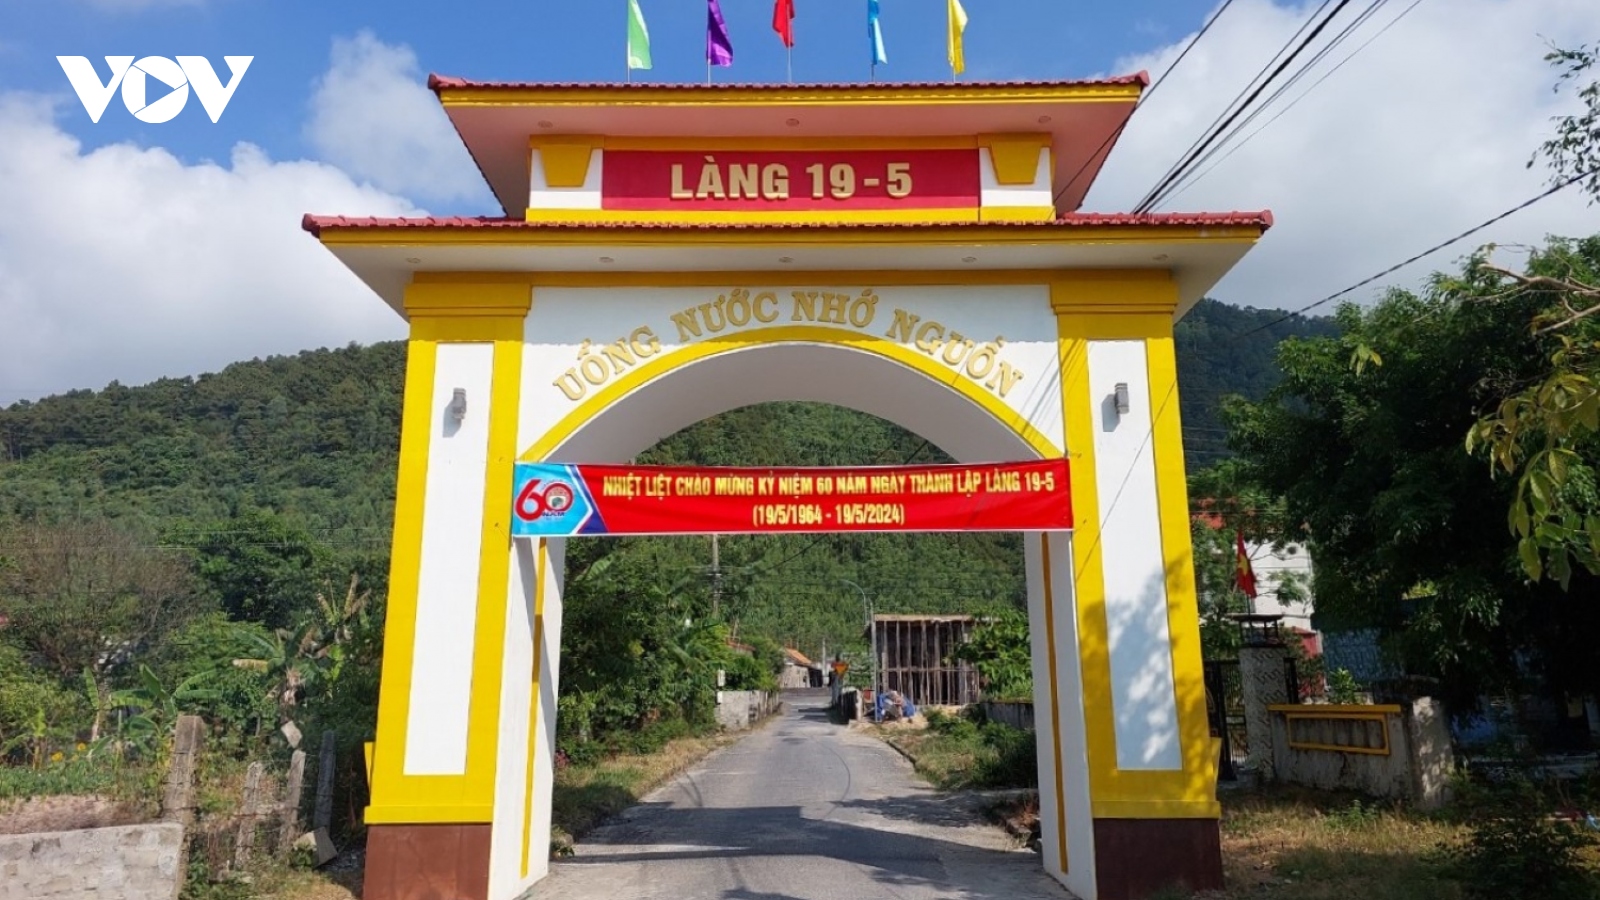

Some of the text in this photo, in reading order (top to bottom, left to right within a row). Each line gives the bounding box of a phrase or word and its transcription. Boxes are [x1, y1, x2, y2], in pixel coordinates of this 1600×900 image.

[670, 155, 790, 200] LÀNG
[552, 287, 1024, 401] UỐNG NƯỚC NHỚ NGUỒN
[603, 467, 1055, 501] NHIỆT LIỆT CHÀO MỪNG KỶ NIỆM 60 NĂM NGÀY THÀNH LẬP LÀNG 19-5
[752, 503, 823, 527] (19/5/1964
[835, 503, 905, 525] 19/5/2024)
